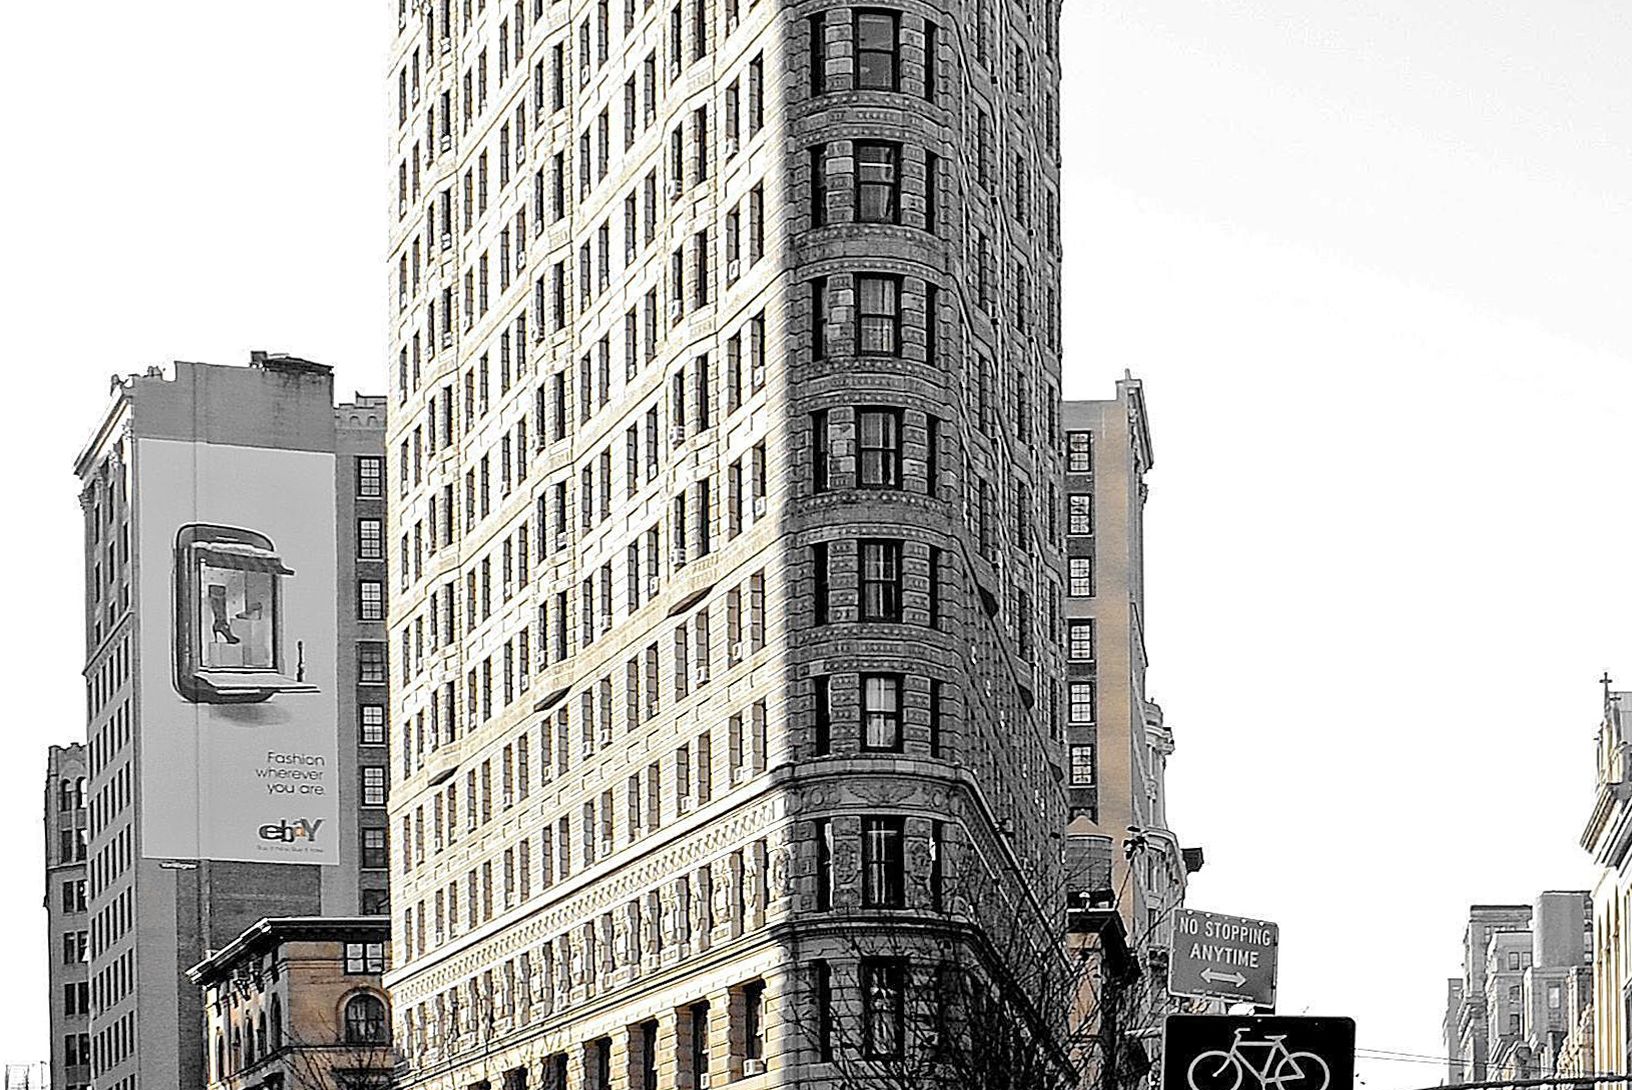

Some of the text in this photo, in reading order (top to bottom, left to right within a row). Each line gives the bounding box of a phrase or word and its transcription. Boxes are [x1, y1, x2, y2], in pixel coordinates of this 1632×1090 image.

[267, 751, 325, 766] Fashion
[256, 766, 323, 780] wherever
[267, 783, 295, 795] you
[1180, 917, 1271, 946] NO STOPPING
[1190, 942, 1260, 968] ANYTIME
